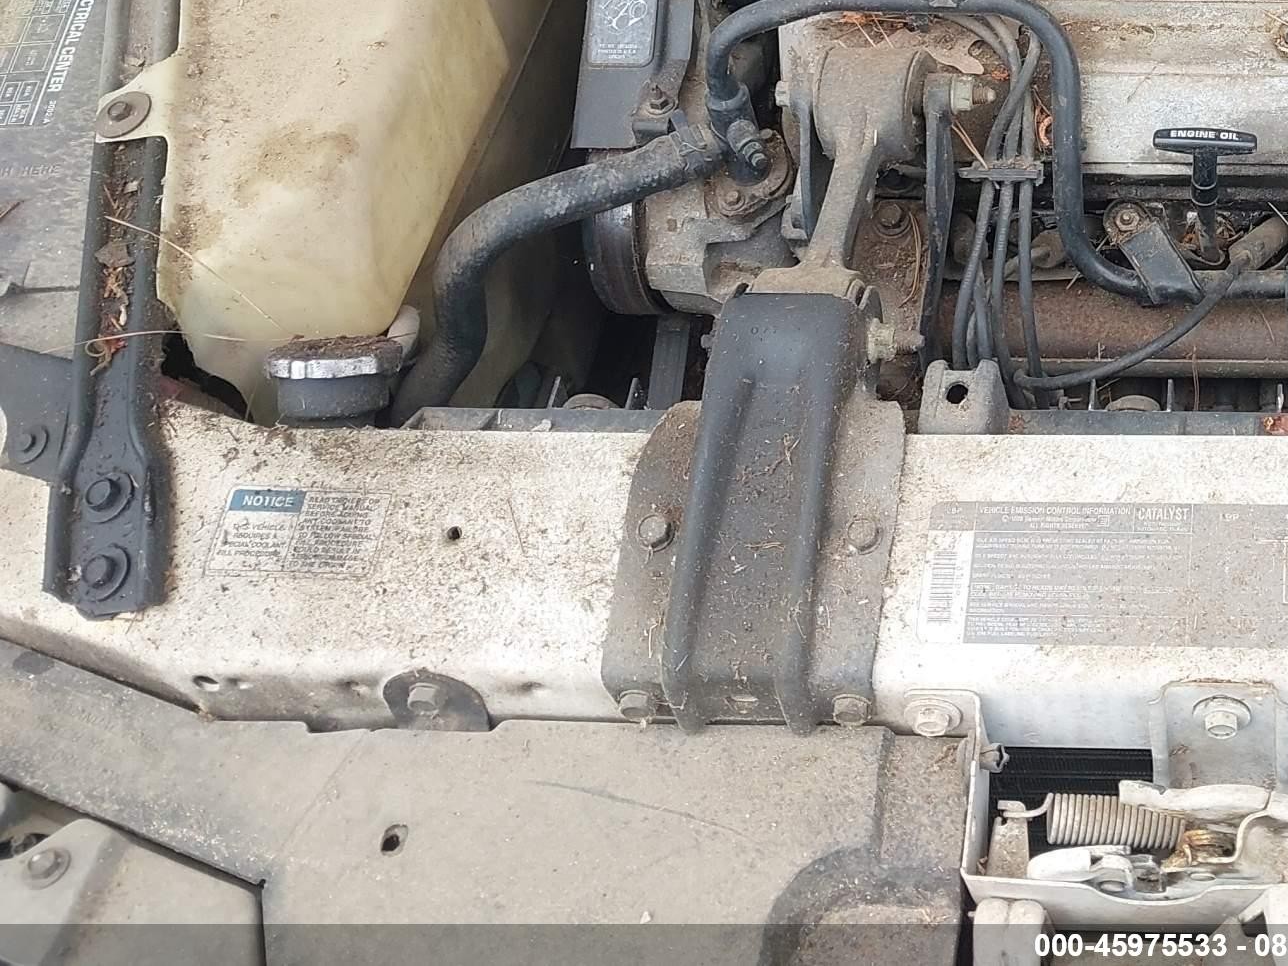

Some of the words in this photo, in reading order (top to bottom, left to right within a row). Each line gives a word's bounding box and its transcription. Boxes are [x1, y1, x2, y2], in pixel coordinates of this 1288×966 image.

[47, 46, 76, 93] CENTER
[1169, 129, 1216, 139] ENGINE
[1219, 131, 1240, 141] OIL
[242, 495, 295, 507] NOTICE
[979, 506, 1010, 514] VEHICLE
[1010, 506, 1045, 515] EMISSION
[1046, 506, 1080, 515] CONTROL
[1081, 506, 1131, 515] INFORMATION
[1138, 507, 1190, 521] CATALYST
